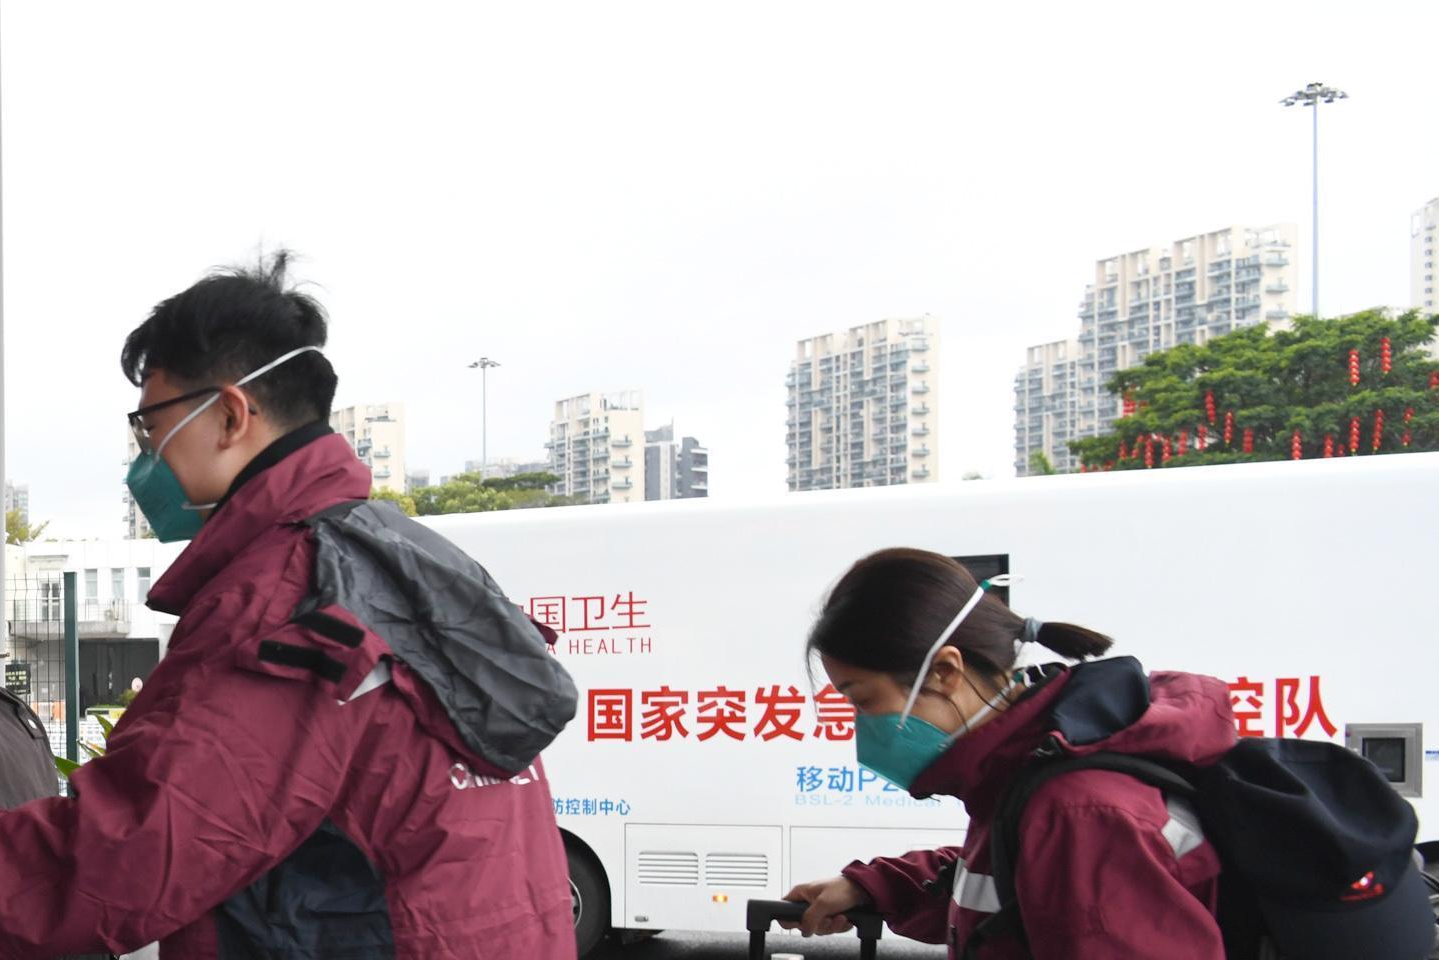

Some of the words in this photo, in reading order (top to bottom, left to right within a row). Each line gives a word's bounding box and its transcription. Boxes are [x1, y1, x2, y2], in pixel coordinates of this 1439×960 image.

[519, 591, 651, 634] 国卫生
[569, 637, 652, 655] HEALTH
[795, 795, 854, 807] BSL-2
